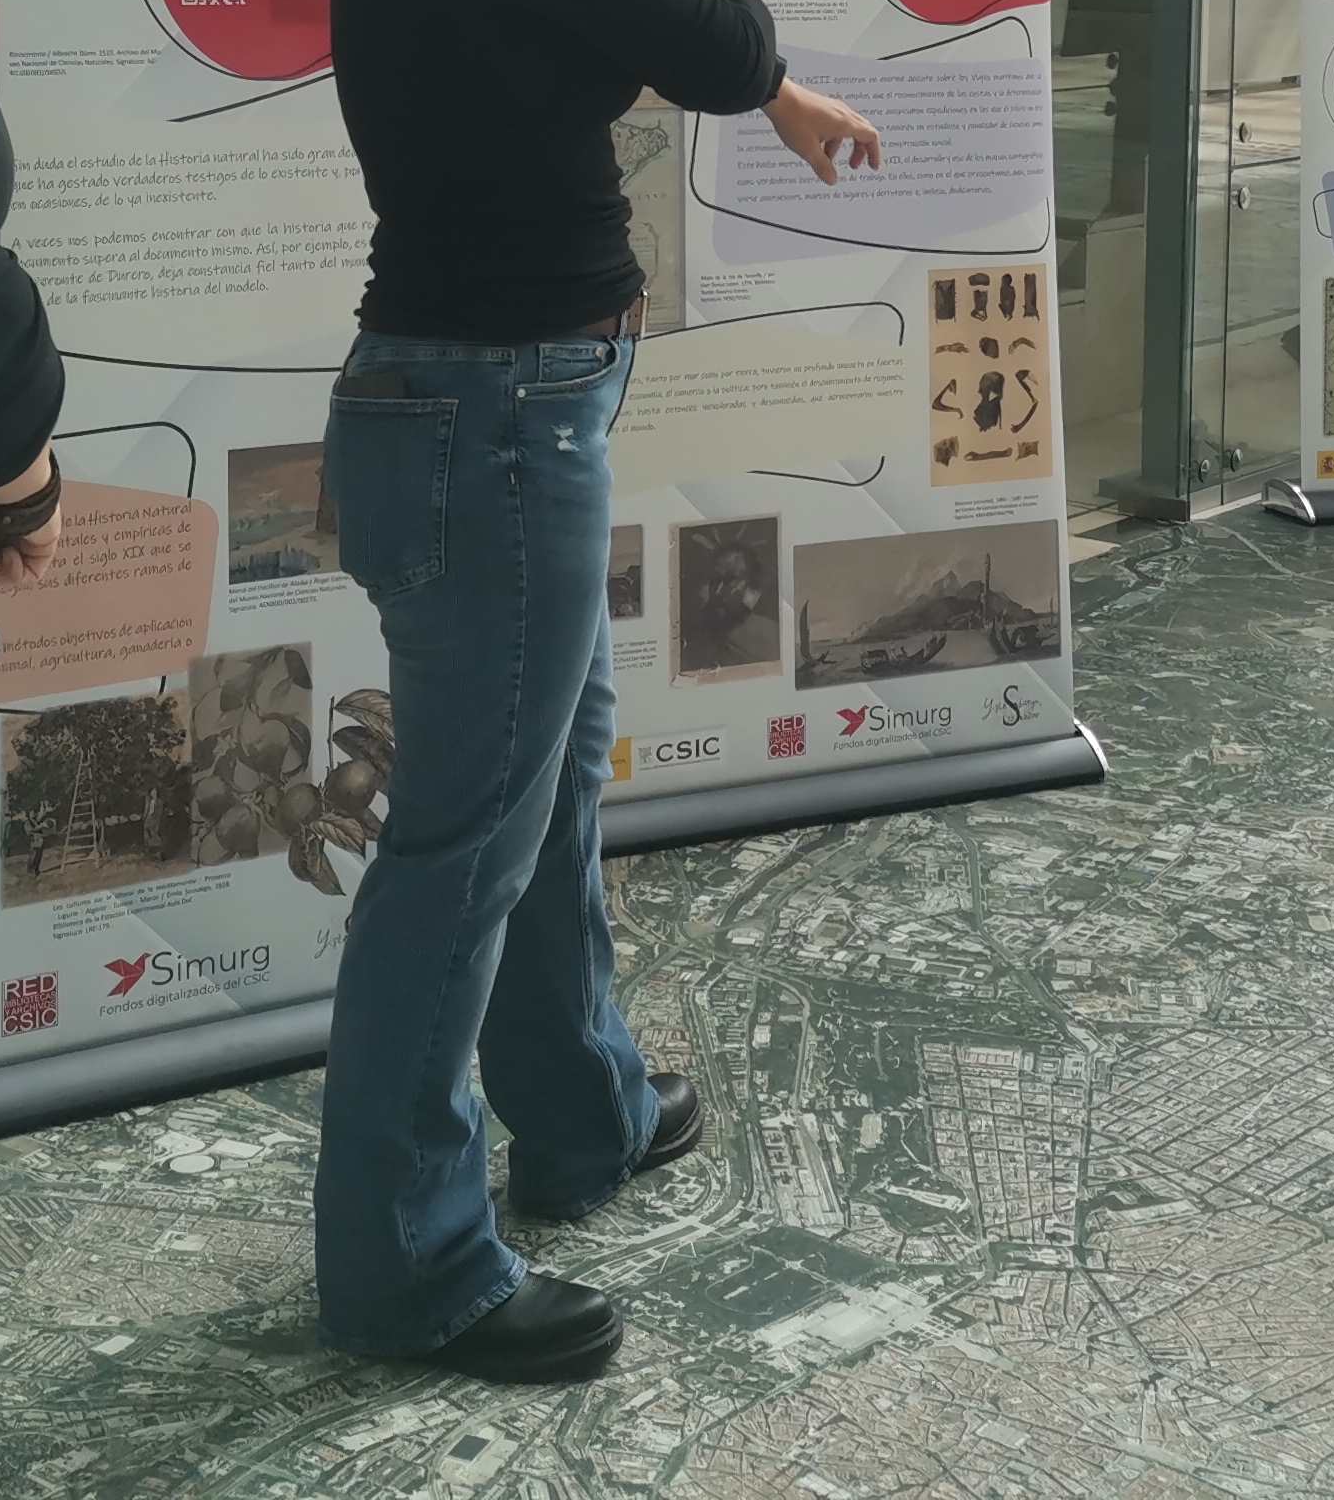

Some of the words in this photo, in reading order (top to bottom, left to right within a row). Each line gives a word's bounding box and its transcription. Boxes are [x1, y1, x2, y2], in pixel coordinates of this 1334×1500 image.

[60, 628, 117, 648] objetivos
[119, 624, 133, 637] de
[136, 618, 192, 635] aplicación
[40, 649, 116, 671] agricultura,
[120, 637, 182, 661] ganadería
[186, 638, 193, 647] o
[768, 714, 806, 733] RED
[868, 705, 952, 731] Simurg
[656, 736, 721, 763] CSIC
[768, 741, 806, 758] CSIC
[833, 739, 865, 751] Fondos
[866, 732, 917, 747] digitalizados
[919, 730, 932, 739] del
[933, 727, 952, 737] CSIC
[151, 945, 270, 986] Simurg
[4, 973, 58, 998] RED
[99, 1000, 144, 1017] Fondos
[147, 983, 222, 1008] digitalizados
[223, 977, 241, 990] del
[242, 971, 270, 985] CSIC
[3, 1008, 58, 1034] CSIC
